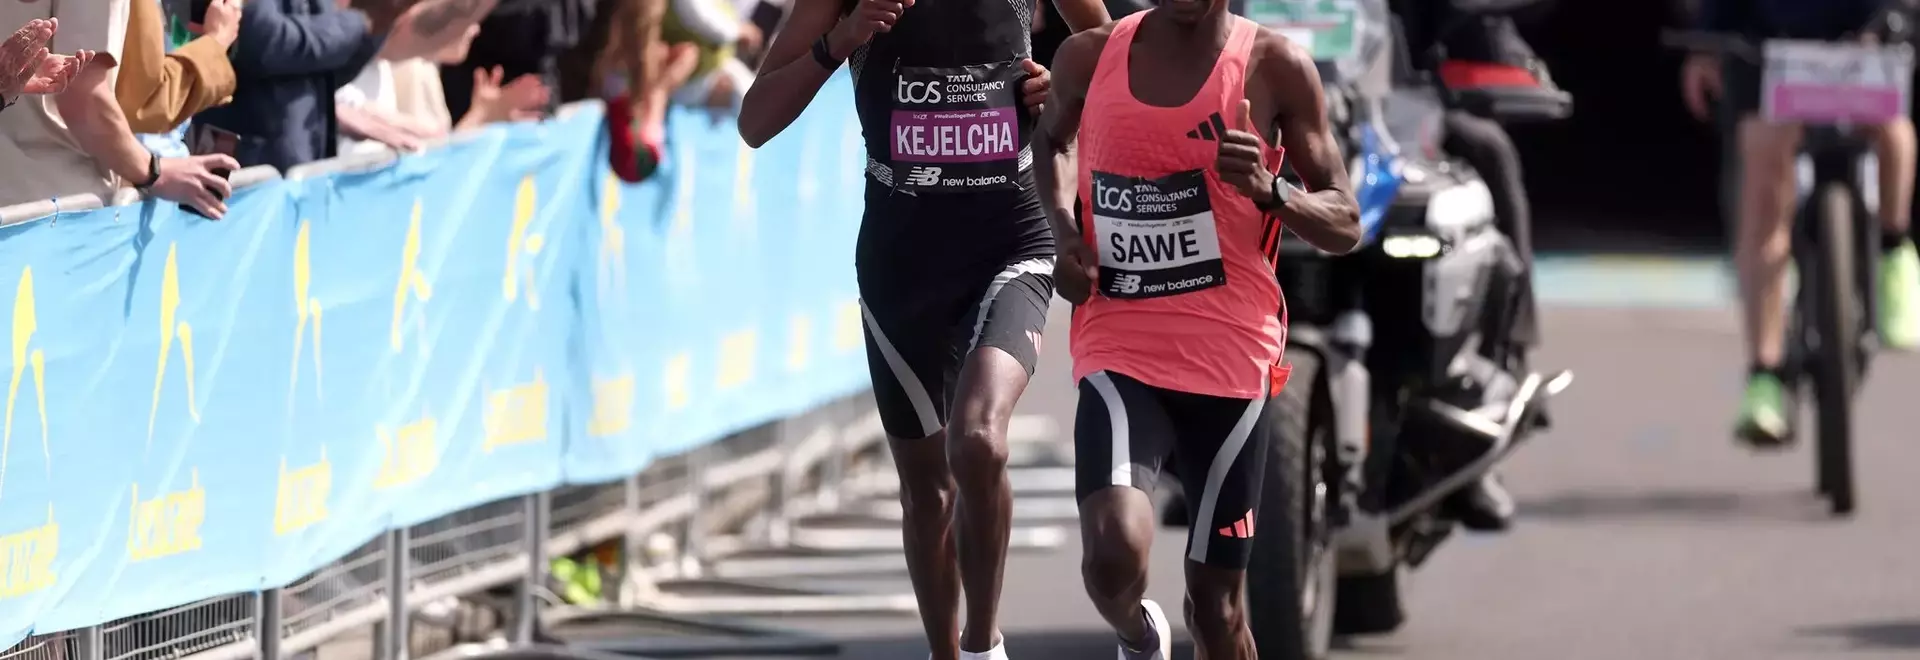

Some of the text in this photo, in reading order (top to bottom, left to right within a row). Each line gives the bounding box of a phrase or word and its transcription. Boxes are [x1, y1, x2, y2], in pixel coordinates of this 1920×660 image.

[946, 75, 974, 83] TATA
[946, 80, 1005, 93] CONSULTANCY
[897, 74, 942, 104] tcs
[946, 93, 987, 103] SERVICES
[896, 121, 1014, 157] KEJELCHA
[942, 175, 1007, 187] new balance
[1096, 178, 1133, 212] tcs
[1135, 187, 1199, 203] CONSULTANCY
[1135, 203, 1178, 214] SERVICES
[1110, 229, 1200, 264] SAWE
[1143, 274, 1214, 293] new balance
